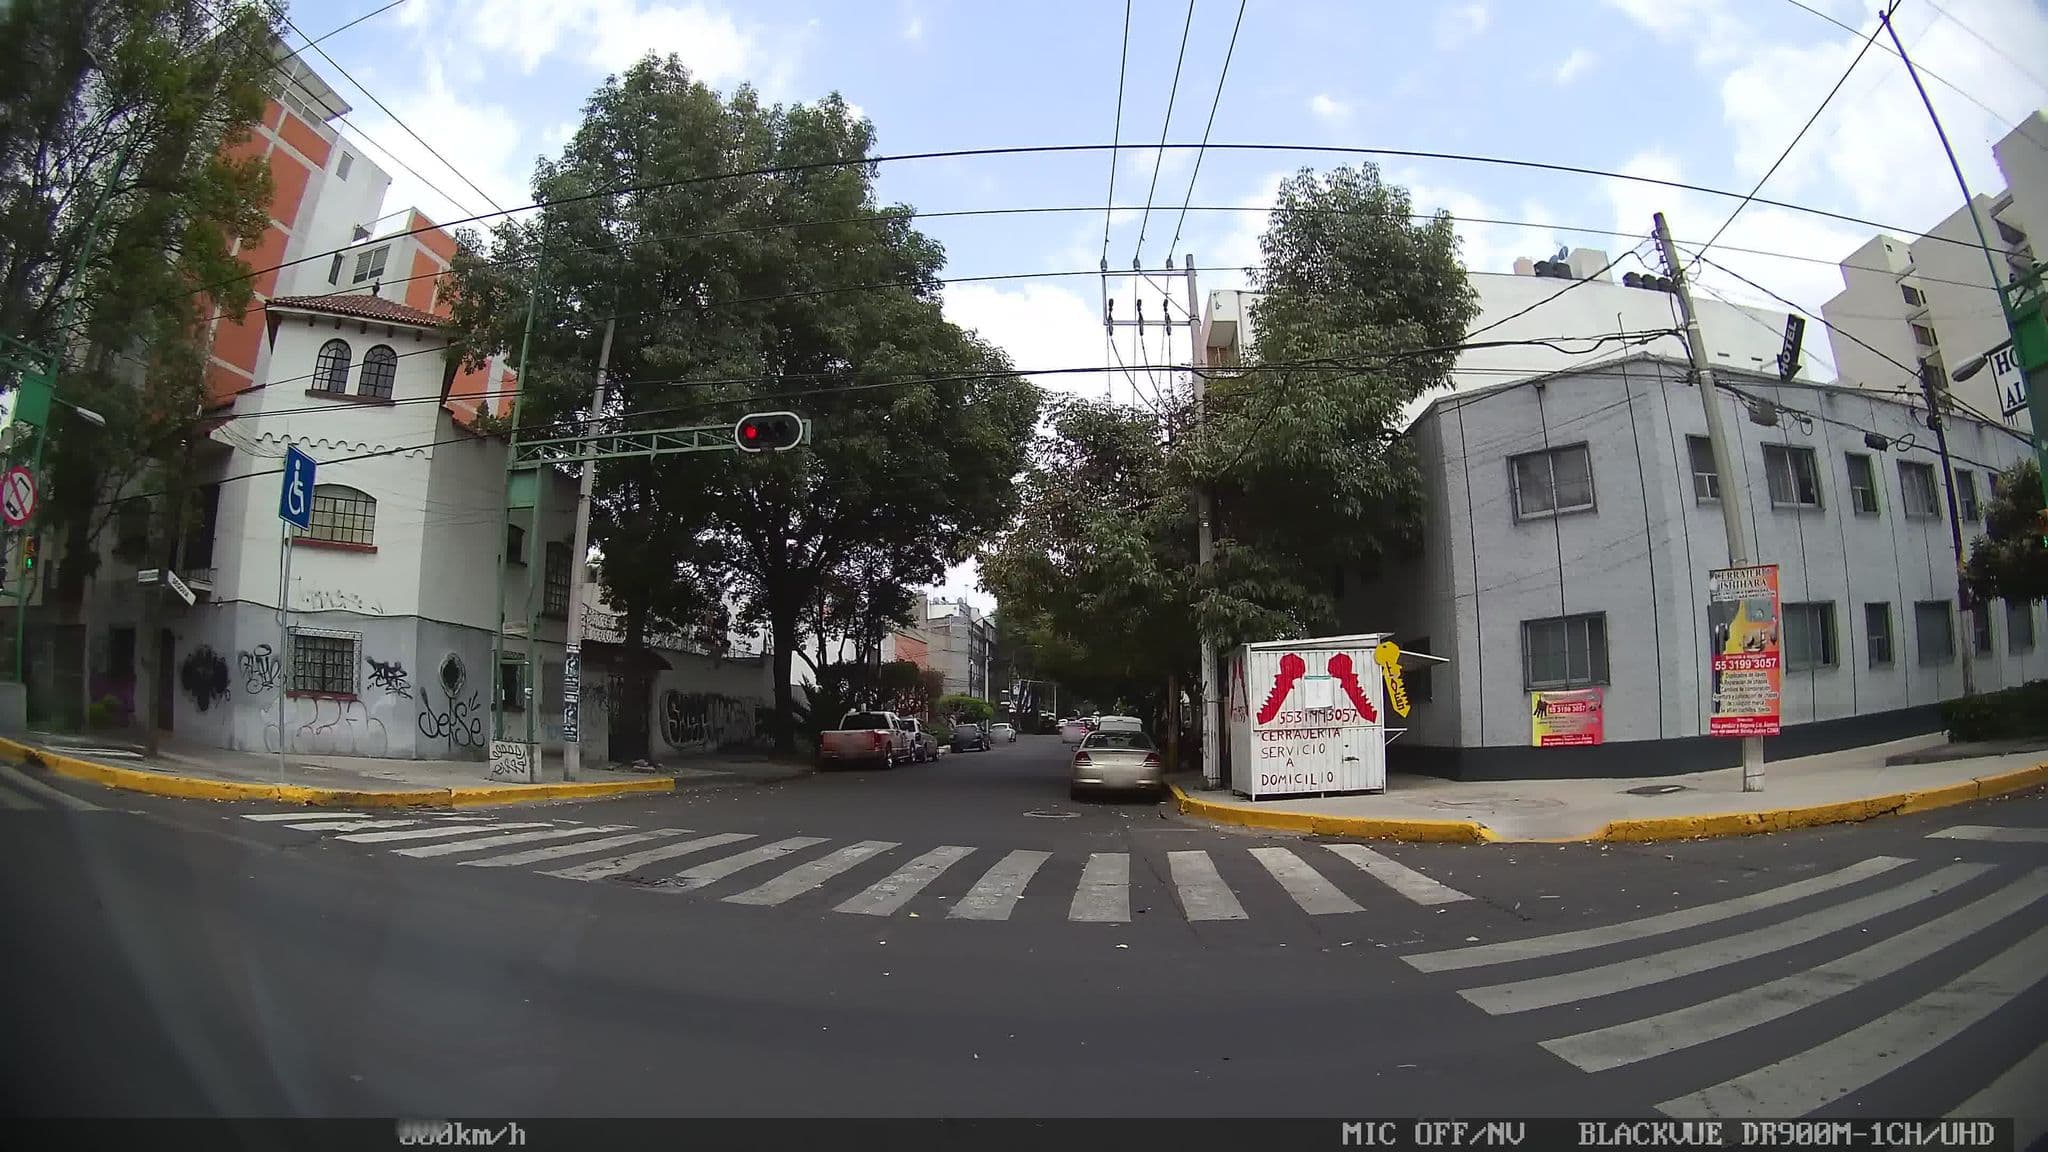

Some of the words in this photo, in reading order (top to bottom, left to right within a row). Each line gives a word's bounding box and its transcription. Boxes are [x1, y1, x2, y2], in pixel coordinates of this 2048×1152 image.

[1780, 321, 1798, 376] HOTEL
[1714, 660, 1728, 672] 55
[1728, 659, 1752, 671] 3199
[1753, 657, 1777, 669] 3057
[1261, 743, 1326, 759] SERVICIO
[1286, 757, 1295, 768] A
[1261, 771, 1334, 786] DOMICILIO
